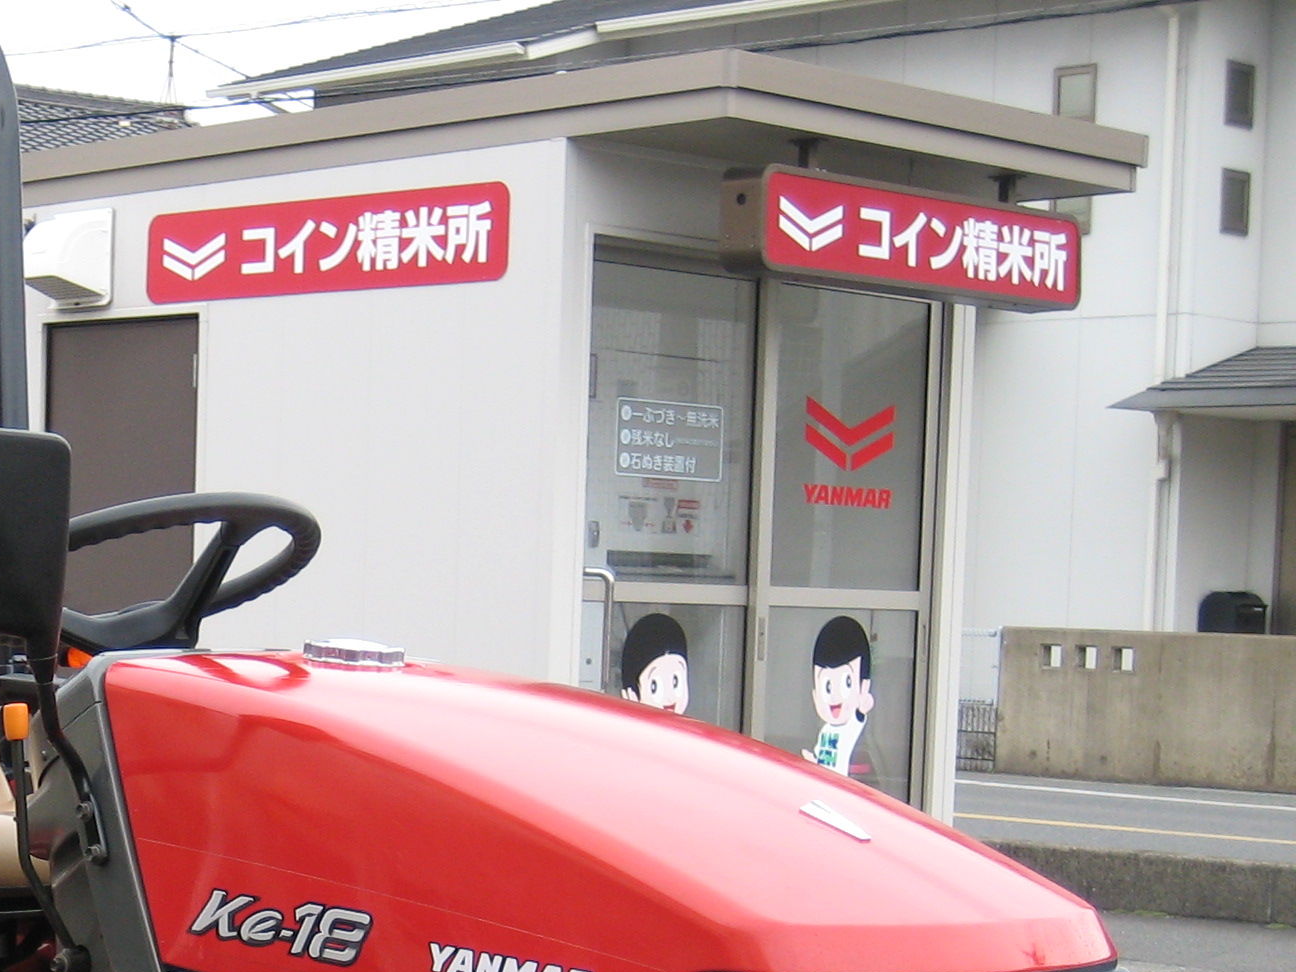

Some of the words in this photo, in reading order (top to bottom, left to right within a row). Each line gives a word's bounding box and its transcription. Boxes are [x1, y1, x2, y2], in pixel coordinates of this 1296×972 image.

[240, 201, 492, 275] コイン精米所
[858, 206, 1068, 292] コイン精米所
[803, 483, 894, 510] YANMAR
[190, 889, 373, 967] Ke-18
